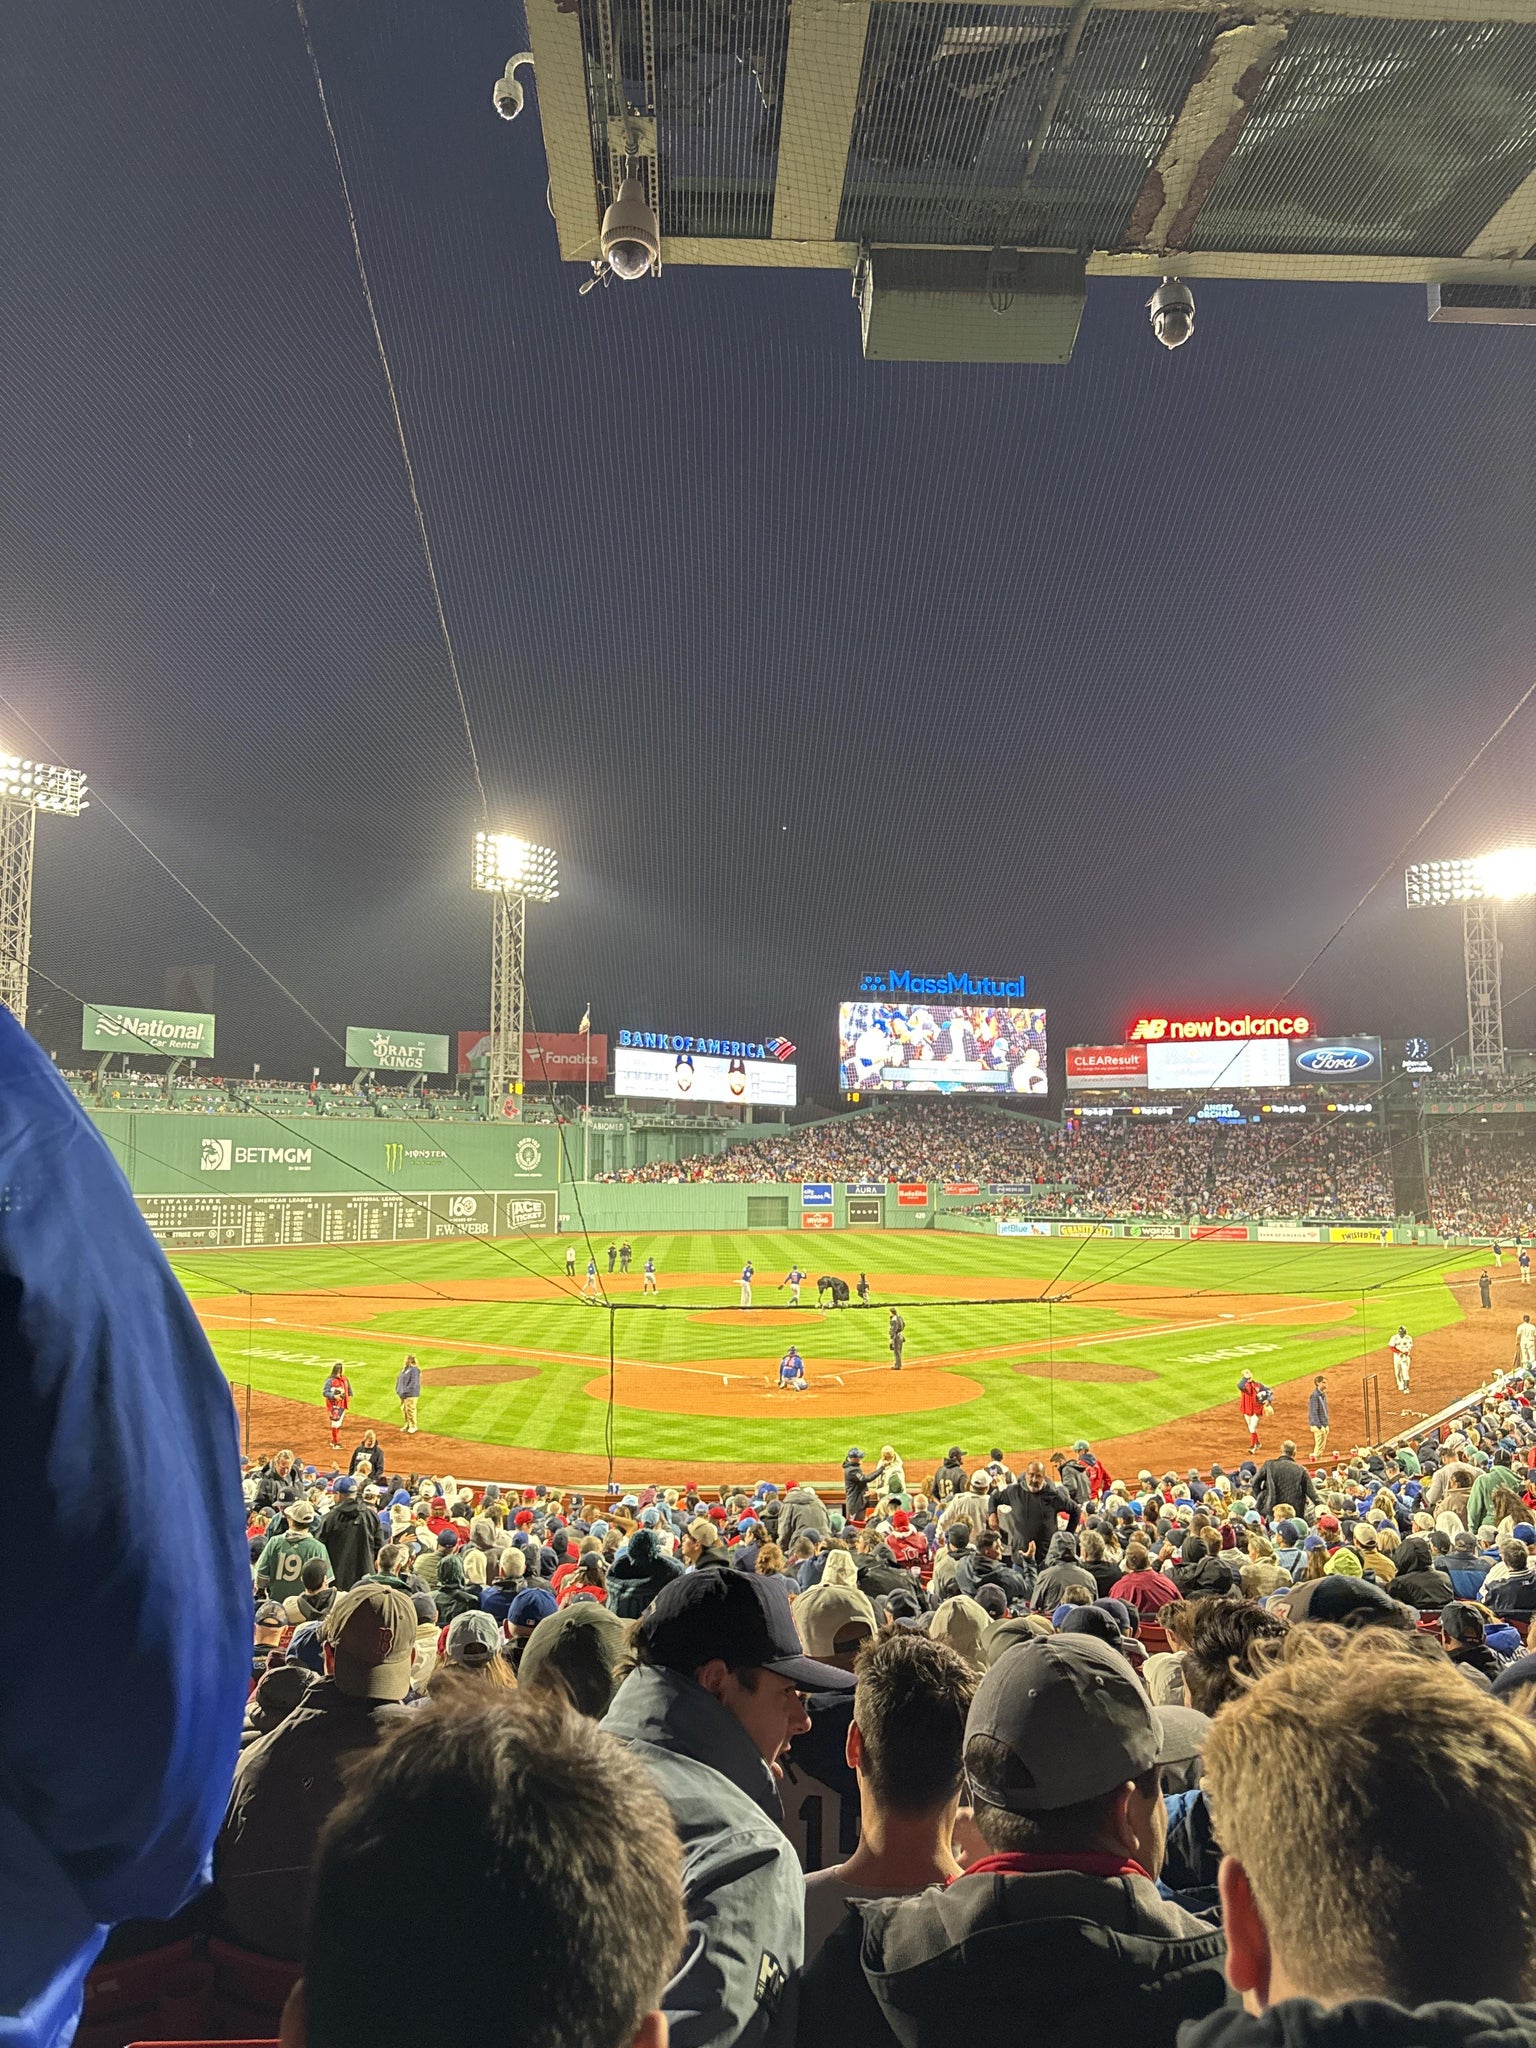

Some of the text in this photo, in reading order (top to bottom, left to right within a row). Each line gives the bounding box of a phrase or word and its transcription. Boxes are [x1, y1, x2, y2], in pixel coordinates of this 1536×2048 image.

[889, 969, 1025, 997] MassMutual
[1170, 1021, 1213, 1038] new
[1215, 1015, 1309, 1036] balance
[150, 1038, 200, 1049] Car Rental
[619, 1029, 766, 1058] BANK OF AMERICA
[373, 1044, 425, 1058] DRAFT
[379, 1055, 423, 1068] KINGS
[545, 1053, 599, 1065] Fanatics
[1074, 1055, 1139, 1066] CLEAResult
[1311, 1051, 1358, 1069] Ford
[1197, 1110, 1240, 1118] ORCHARD
[592, 1122, 624, 1131] ABIOMED
[235, 1147, 312, 1163] BETMGM
[405, 1150, 448, 1158] MONSTER
[449, 1196, 477, 1216] 160
[514, 1201, 542, 1215] ACE
[515, 1212, 542, 1222] TICKET
[435, 1222, 489, 1236] F.W. WEBB
[1001, 1224, 1027, 1234] jetBlue
[1142, 1226, 1175, 1235] wasabi
[1341, 1231, 1381, 1241] TWISTED TEA
[275, 1551, 302, 1582] 19
